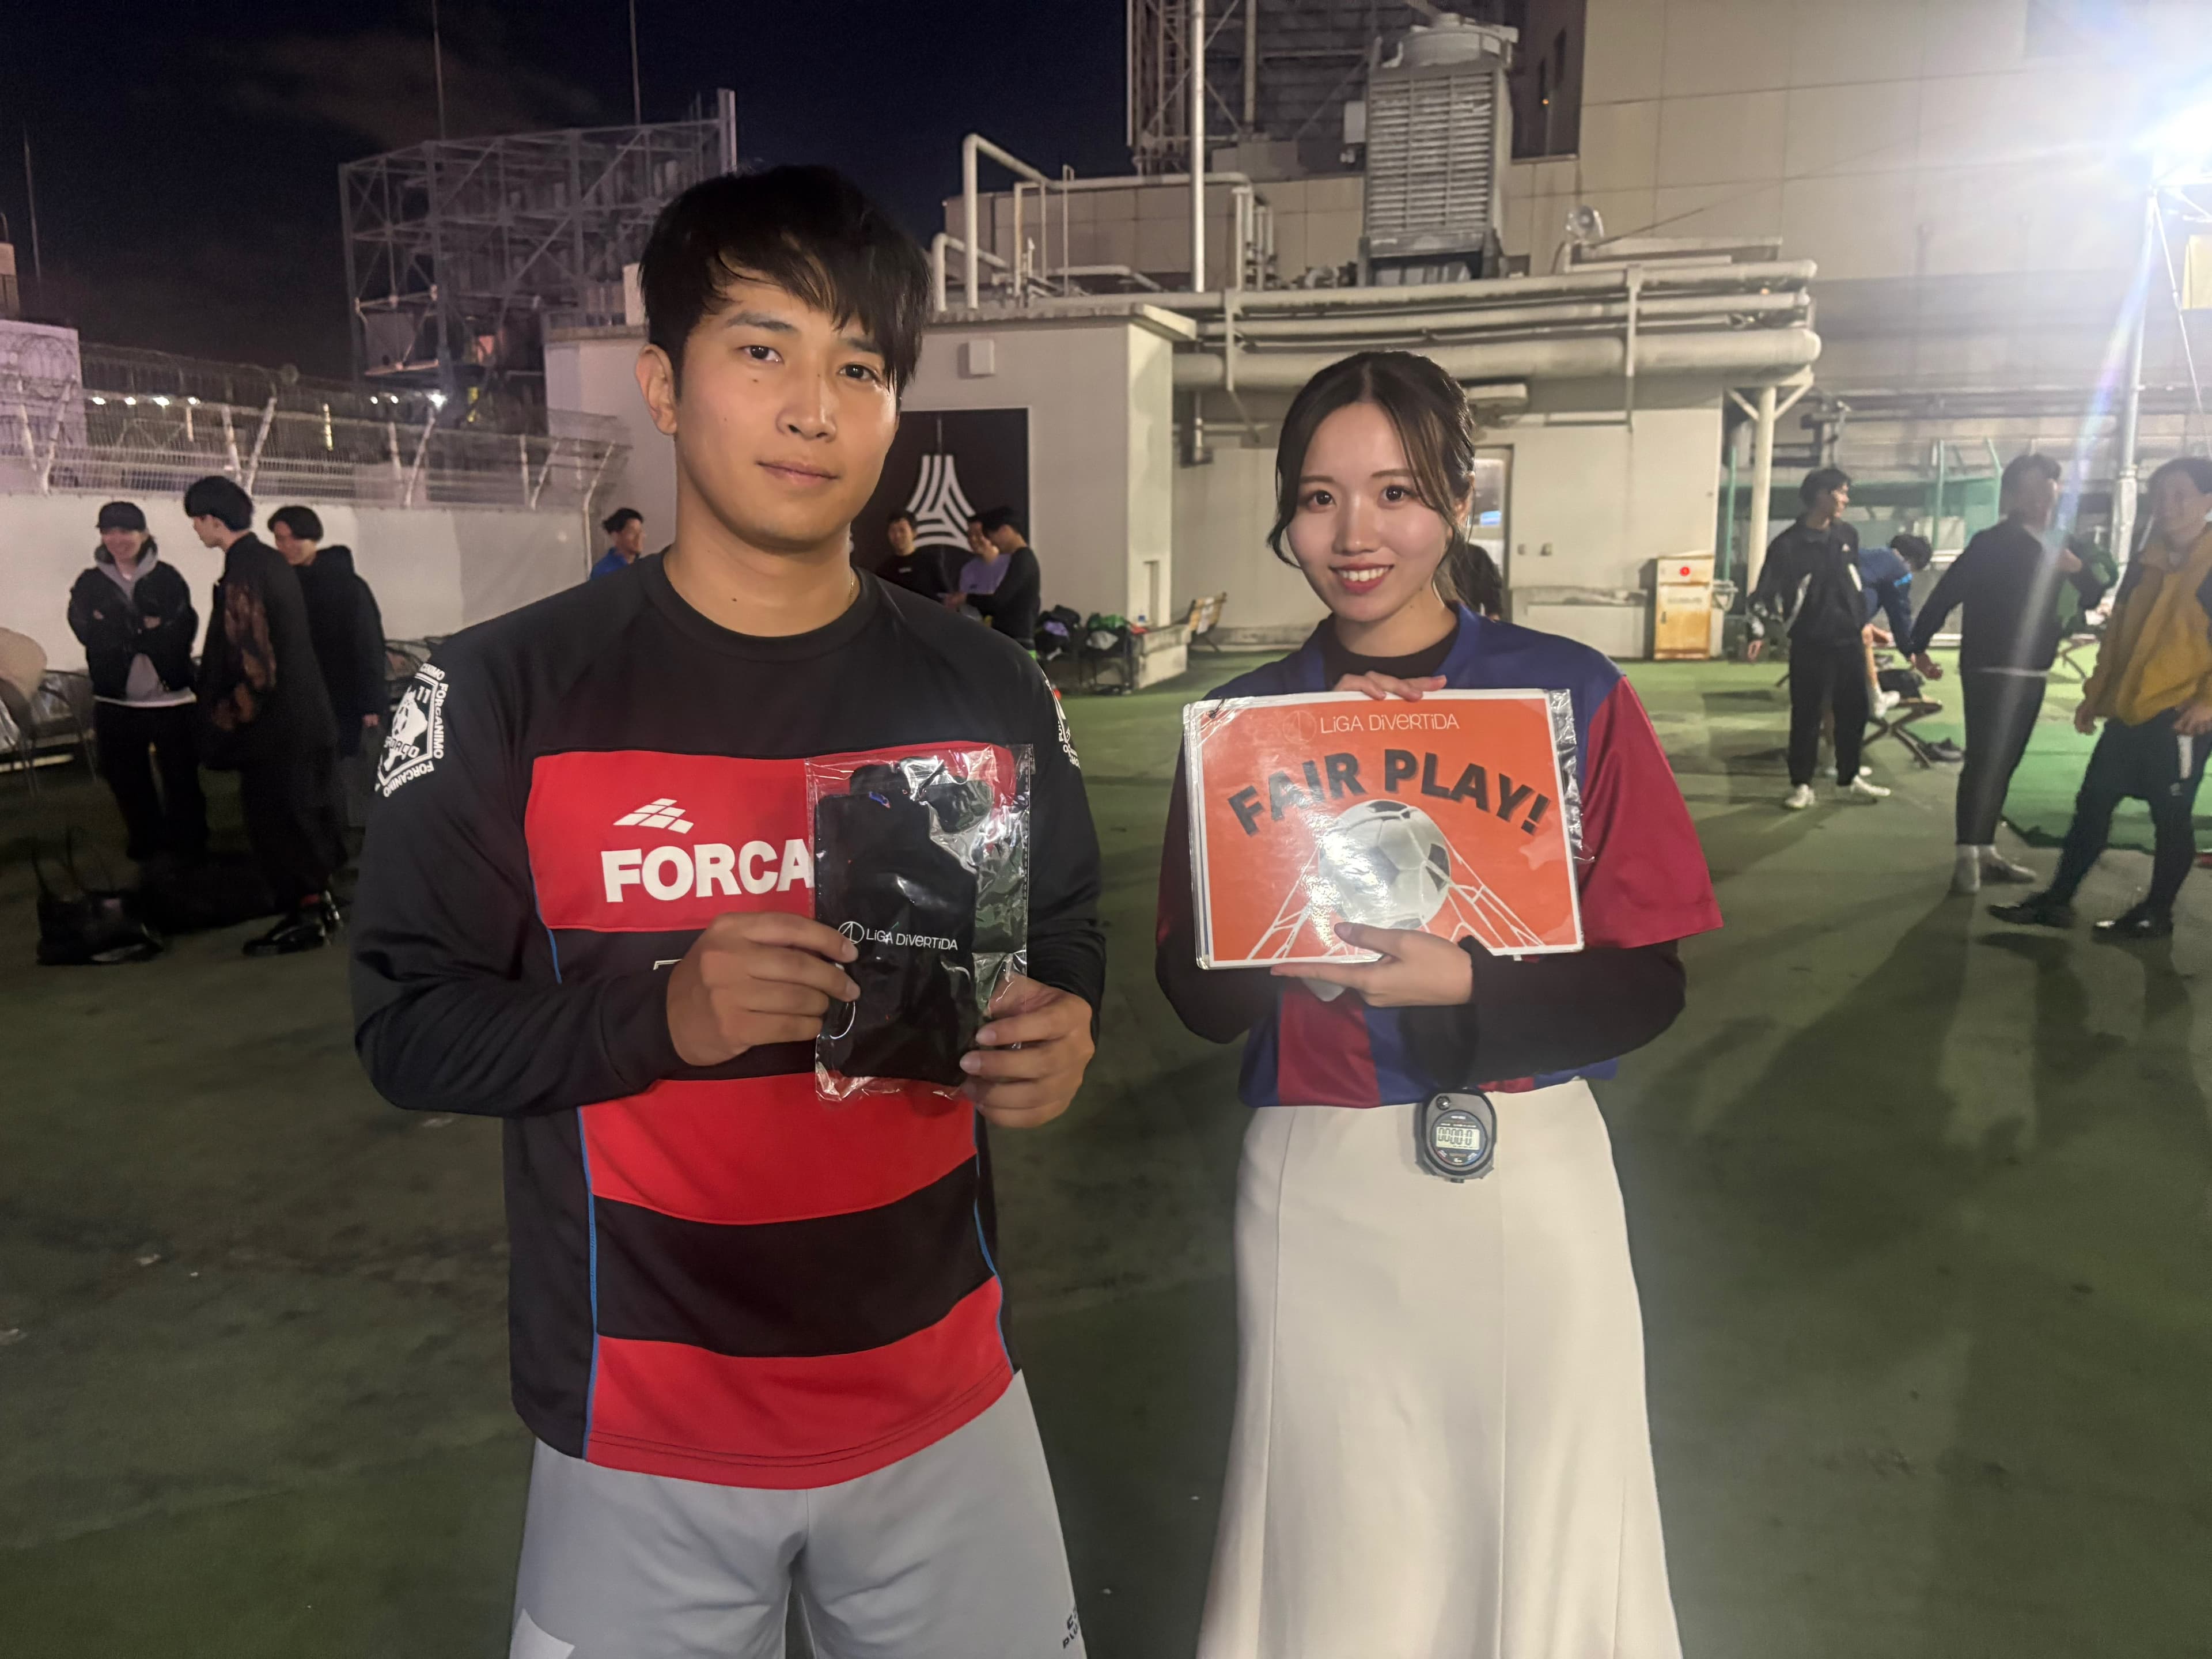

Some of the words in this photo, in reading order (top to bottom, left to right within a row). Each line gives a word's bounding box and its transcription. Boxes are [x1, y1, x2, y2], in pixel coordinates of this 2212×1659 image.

[416, 685, 431, 704] 11
[433, 683, 449, 759] FORCANIMO
[1227, 752, 1368, 836] FAIR
[1384, 748, 1551, 835] PLAY!
